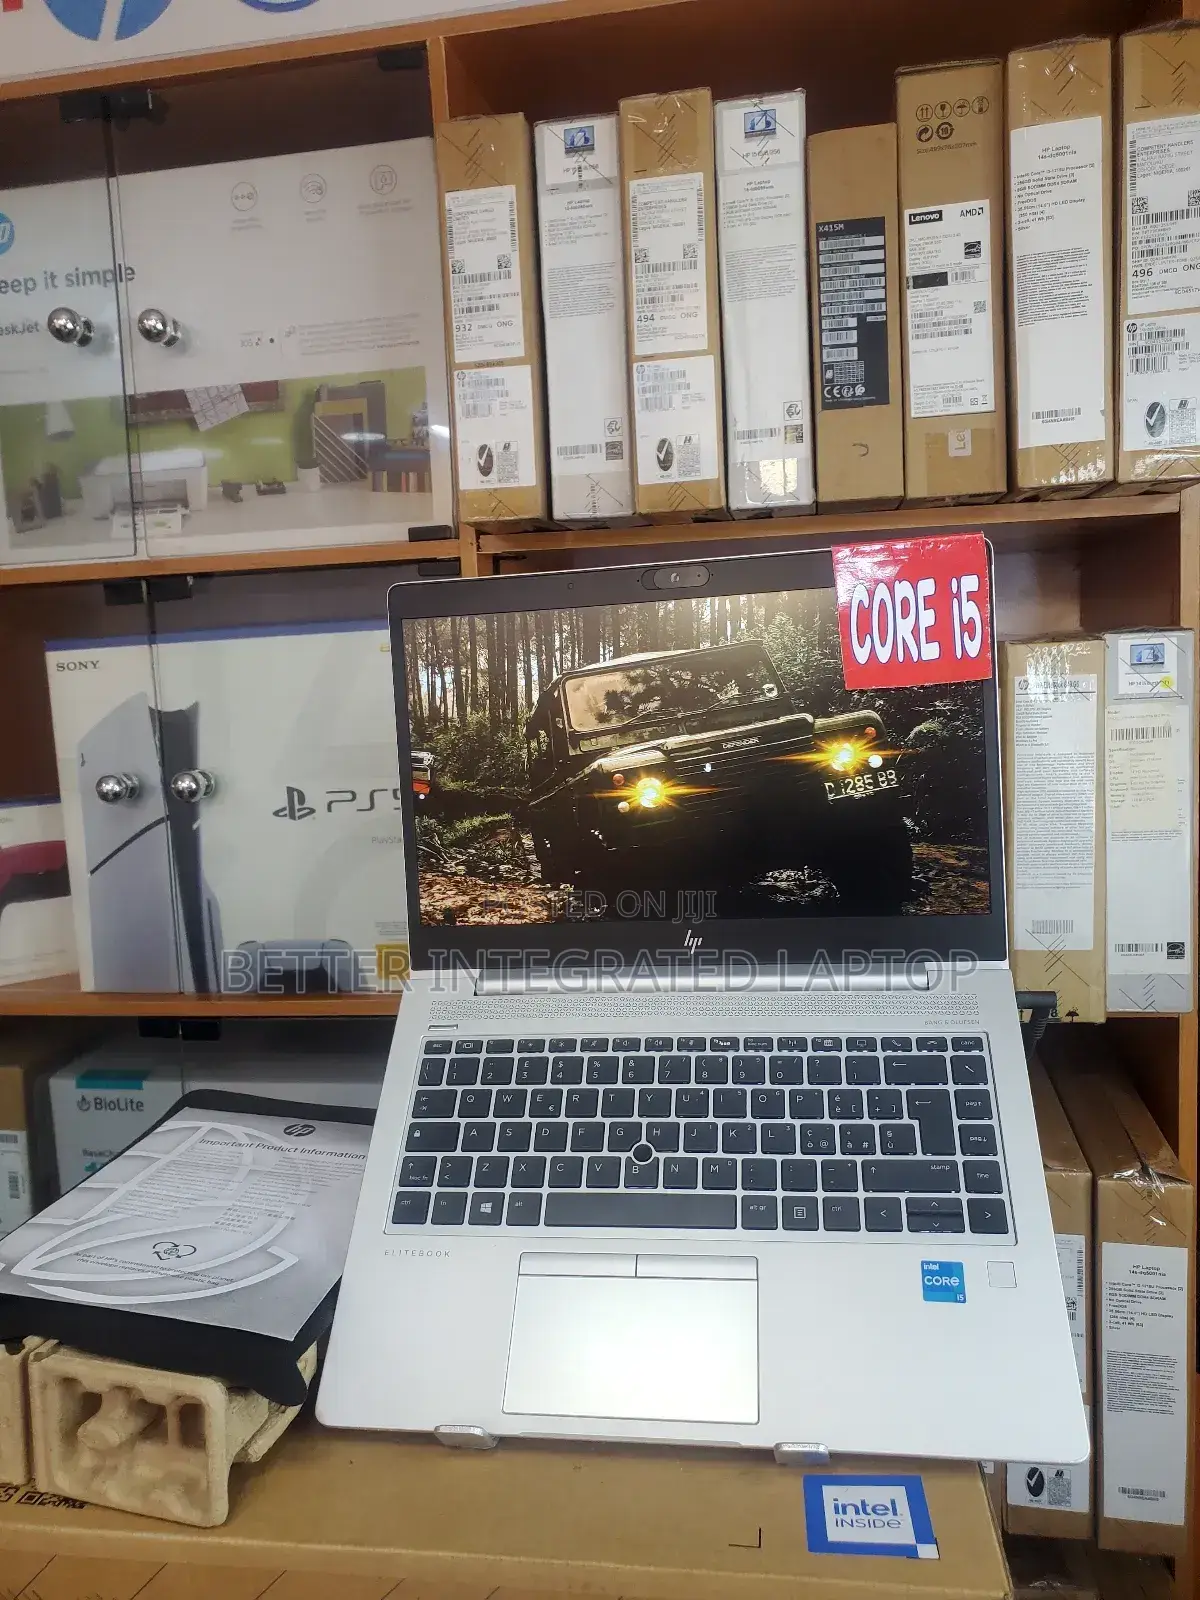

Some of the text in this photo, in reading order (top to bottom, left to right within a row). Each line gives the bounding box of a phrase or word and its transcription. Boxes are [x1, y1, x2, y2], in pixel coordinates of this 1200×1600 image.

[911, 208, 976, 222] Lenovo AMD
[818, 224, 844, 232] X415M
[1132, 268, 1153, 278] 496
[1182, 262, 1200, 272] ONG
[44, 270, 58, 290] it
[65, 263, 136, 288] simple
[636, 314, 655, 322] 494
[456, 320, 514, 332] 932 ONG
[850, 573, 983, 665] CORE i5
[56, 660, 99, 672] SONY
[466, 1094, 475, 1103] Q
[502, 1094, 514, 1103] W
[536, 1094, 544, 1102] E
[572, 1094, 580, 1102] R
[609, 1093, 615, 1102] T
[645, 1093, 654, 1102] Y
[682, 1094, 690, 1102] U
[796, 1095, 804, 1103] P
[94, 1097, 144, 1112] BioLite
[469, 1128, 478, 1136] A
[505, 1128, 513, 1137] S
[541, 1128, 550, 1136] D
[578, 1128, 584, 1136] F
[616, 1127, 624, 1136] G
[653, 1127, 661, 1136] H
[690, 1128, 697, 1137] J
[729, 1129, 737, 1138] K
[768, 1129, 775, 1138] L
[819, 1139, 829, 1149] @
[199, 1138, 366, 1160] Important Product Information
[482, 1163, 490, 1172] Z
[518, 1163, 527, 1172] X
[556, 1163, 565, 1172] C
[594, 1163, 603, 1172] V
[632, 1165, 640, 1174] B
[670, 1163, 679, 1173] N
[710, 1164, 719, 1173] M
[384, 1250, 450, 1258] ELITEBOOK
[923, 1262, 940, 1270] intel
